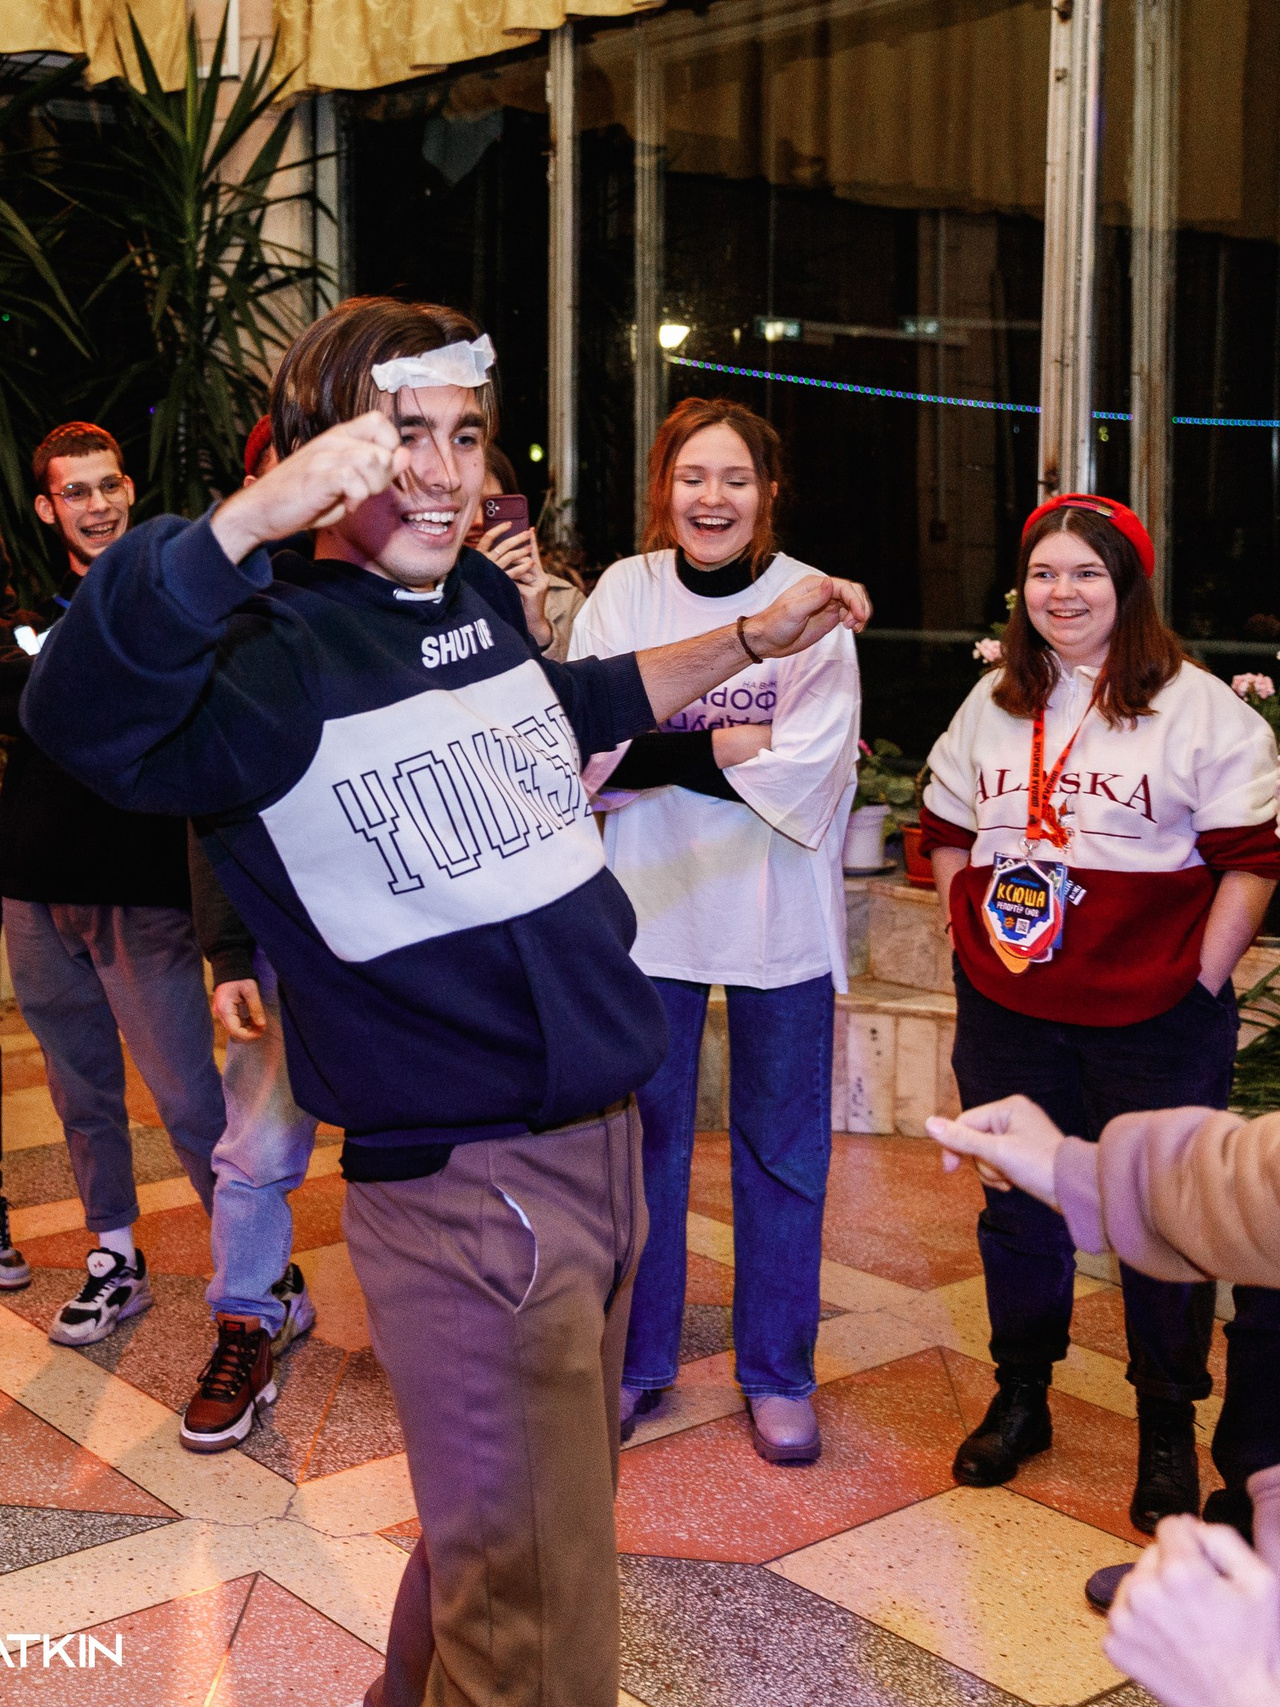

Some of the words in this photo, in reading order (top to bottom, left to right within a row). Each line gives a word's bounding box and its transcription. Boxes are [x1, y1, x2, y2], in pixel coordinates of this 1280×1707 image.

[421, 624, 478, 669] SHUT
[974, 766, 1158, 824] ALSKA
[996, 882, 1047, 908] КСЮША
